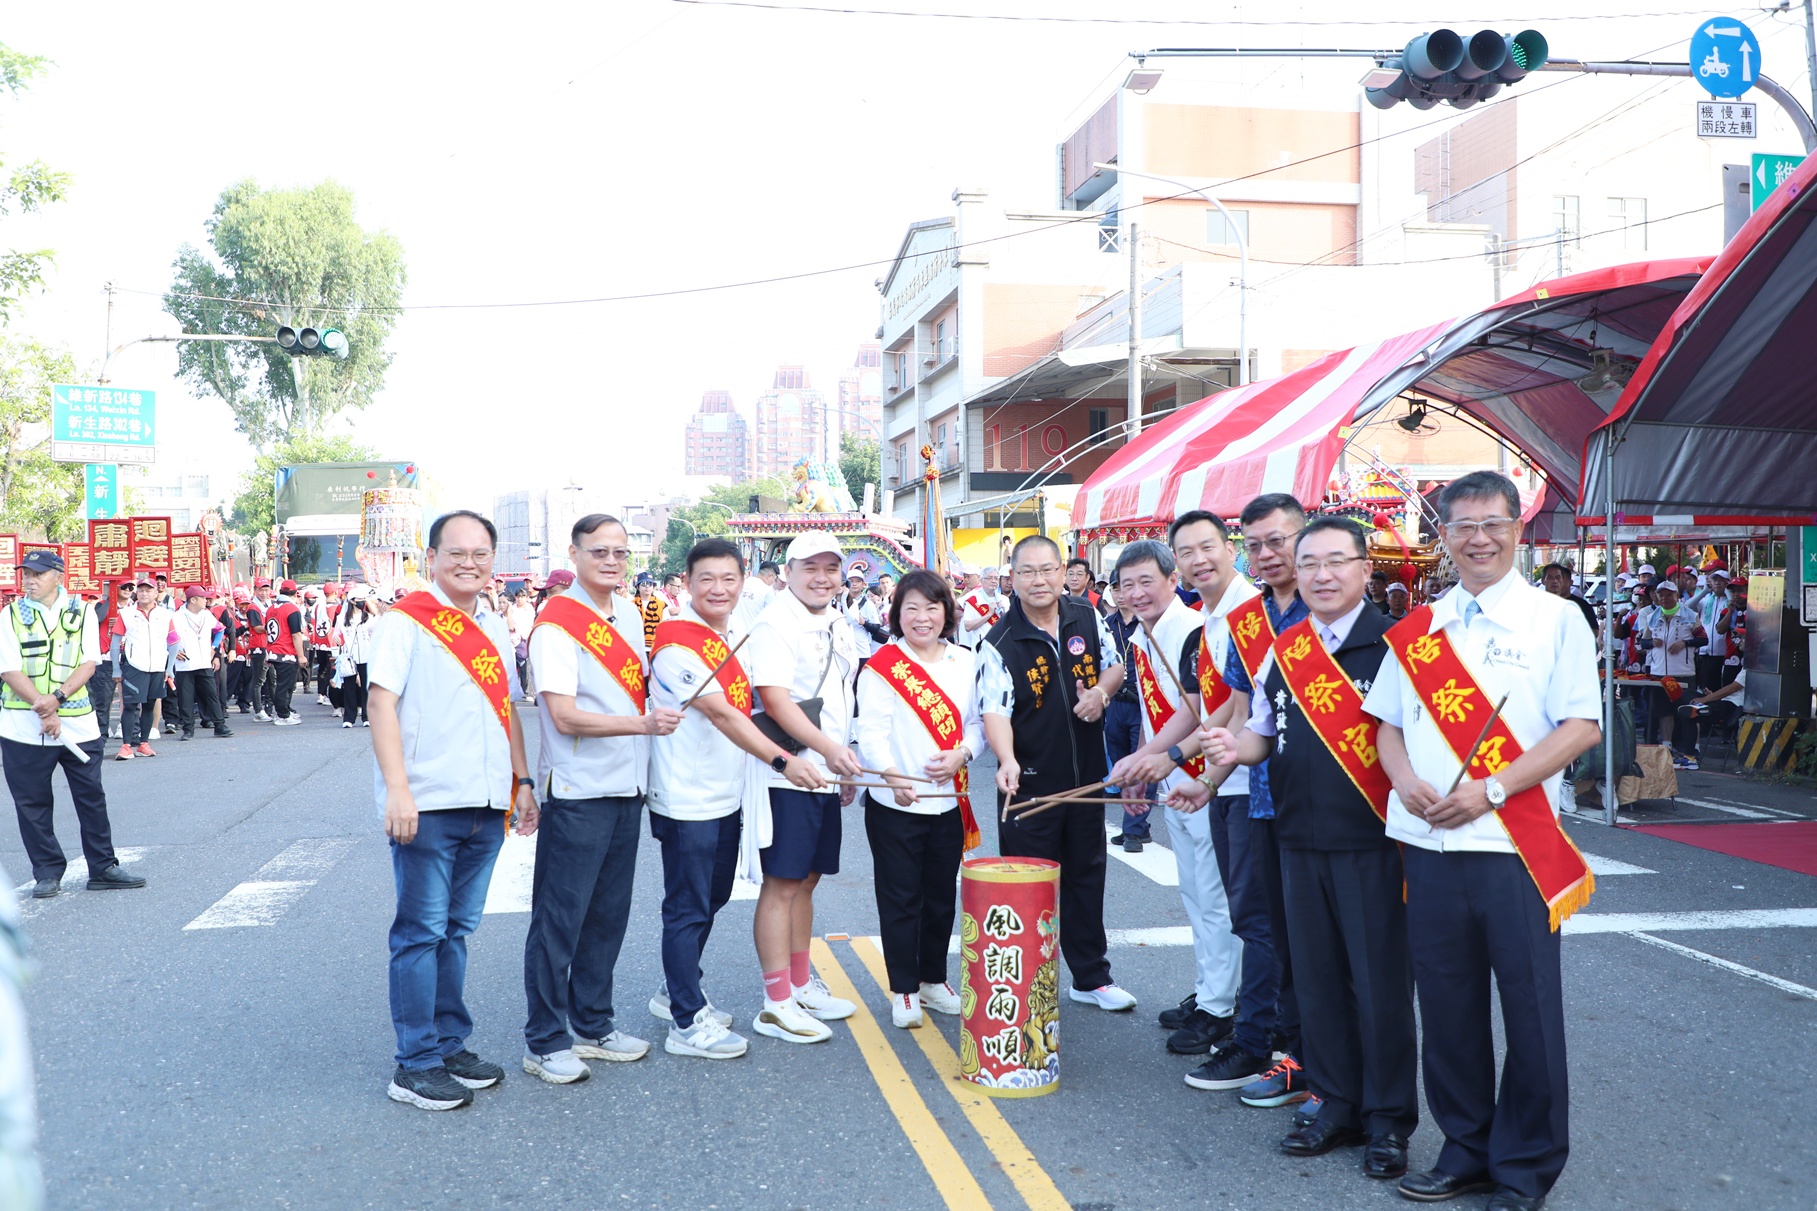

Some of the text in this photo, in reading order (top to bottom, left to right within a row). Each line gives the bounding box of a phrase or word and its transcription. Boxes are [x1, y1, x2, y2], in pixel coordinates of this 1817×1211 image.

[1701, 105, 1752, 120] 機慢車
[1701, 120, 1752, 135] 兩段左轉
[68, 388, 142, 406] 維新路134巷
[101, 405, 127, 414] Weixin
[128, 407, 141, 415] Rd.
[68, 415, 142, 433] 新生路302巷
[130, 433, 141, 441] Rd.
[986, 423, 1068, 473] 119
[94, 523, 129, 576] 肅靜
[134, 520, 169, 568] 迴避
[1236, 611, 1263, 649] 陪
[586, 621, 643, 692] 陪祭
[702, 637, 750, 709] 陪祭
[889, 658, 958, 741] 榮譽總顧問
[1282, 633, 1379, 768] 陪祭官
[1405, 633, 1511, 776] 陪祭官
[984, 905, 1023, 1065] 風調雨順
